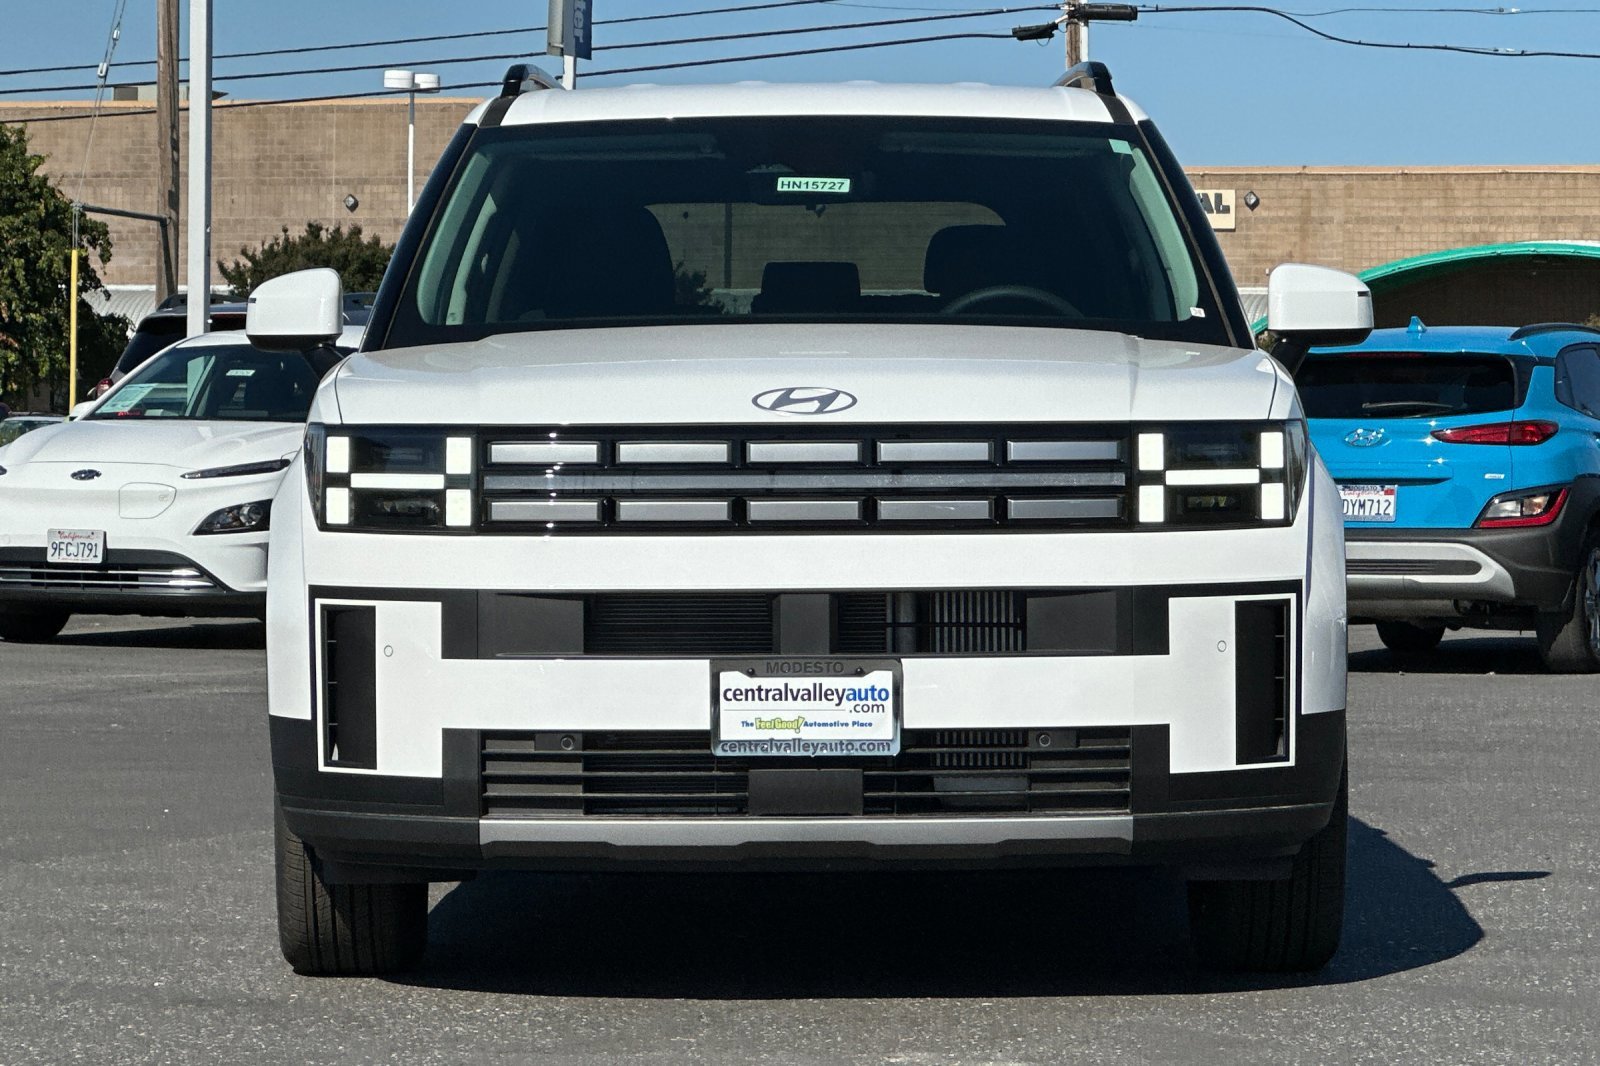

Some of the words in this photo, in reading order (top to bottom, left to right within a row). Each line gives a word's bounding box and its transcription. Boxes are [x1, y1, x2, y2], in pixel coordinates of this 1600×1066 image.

[780, 180, 845, 191] HN15727
[50, 541, 99, 558] 9FCJ791
[766, 661, 845, 674] MODESTO
[723, 682, 890, 707] centralvalleyauto
[849, 703, 885, 713] .com
[741, 720, 754, 728] The
[803, 720, 850, 728] Automotive
[851, 720, 873, 728] Place
[720, 738, 891, 756] centralvalleyauto.com
